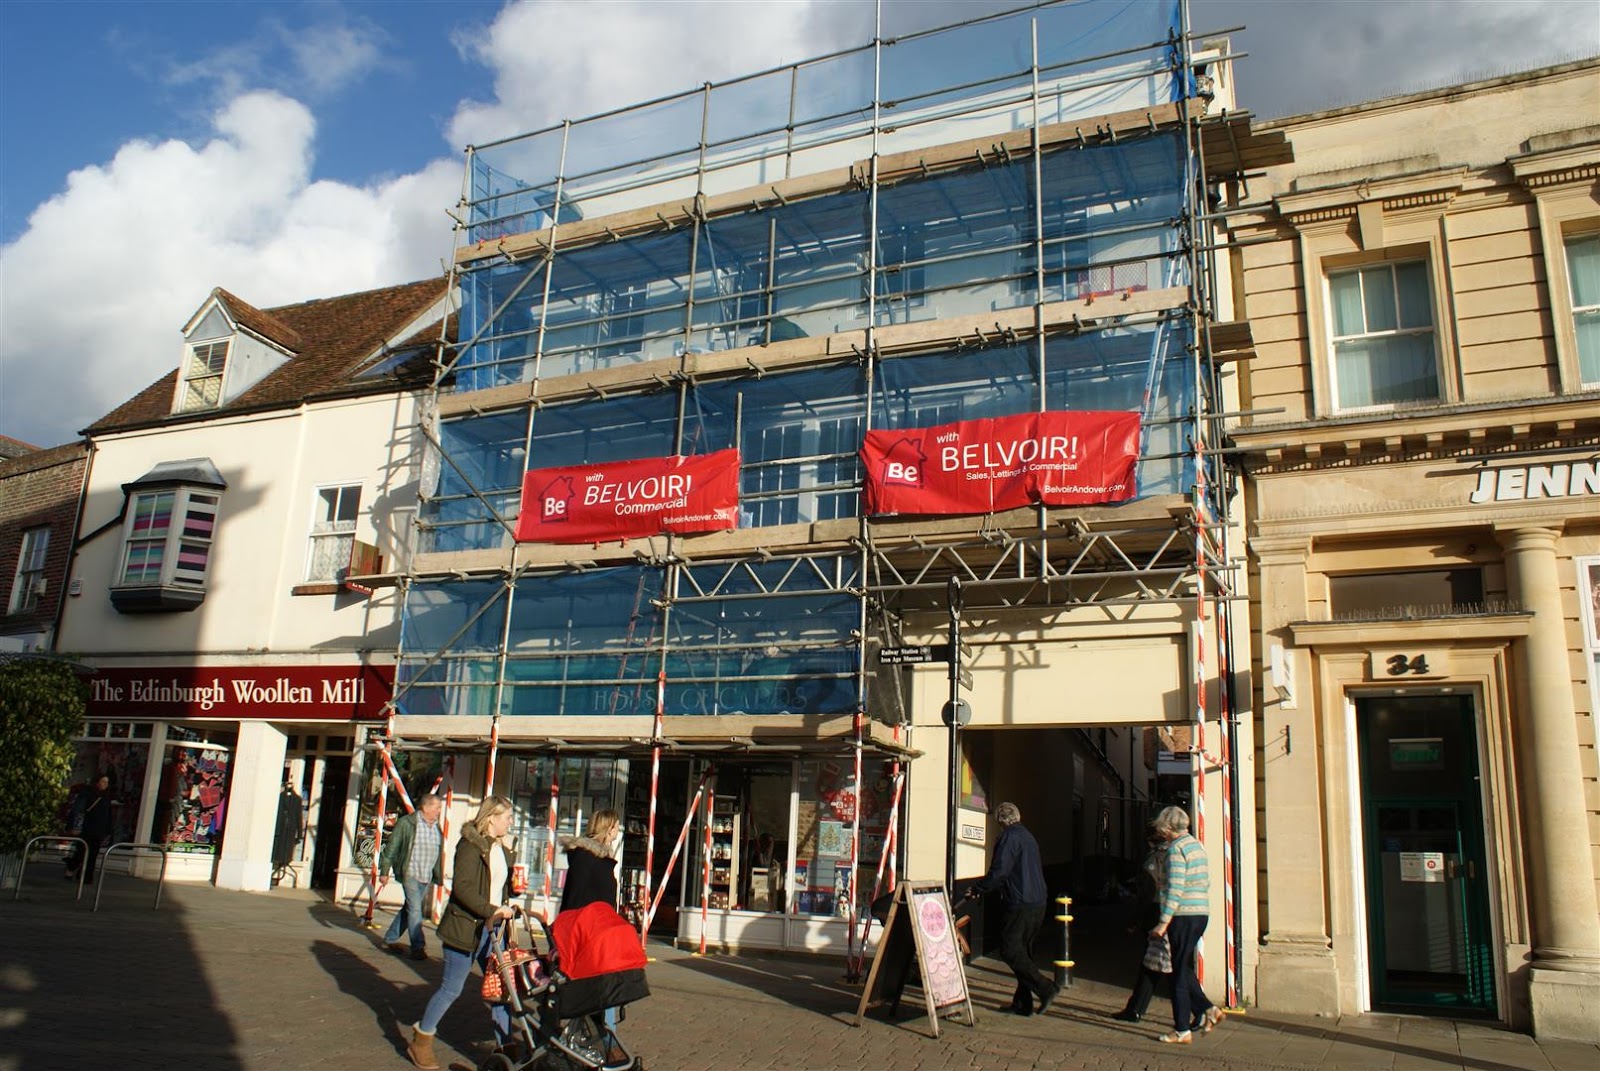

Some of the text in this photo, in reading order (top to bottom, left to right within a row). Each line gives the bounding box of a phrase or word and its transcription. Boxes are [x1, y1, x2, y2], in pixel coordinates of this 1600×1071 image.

[936, 432, 960, 444] with
[941, 436, 1078, 472] BELVOIR!
[585, 473, 604, 483] with
[887, 462, 918, 482] Be
[966, 471, 991, 481] Sales,
[992, 468, 1021, 479] Lettings
[1029, 462, 1078, 472] Commercial
[584, 475, 692, 506] BELVOIR!
[1044, 483, 1125, 495] BelvoirAndover.com
[545, 497, 566, 516] Be
[615, 494, 688, 516] Commercial
[663, 511, 730, 525] BelvoirAndover.com
[1386, 654, 1429, 676] 34
[91, 677, 366, 710] The Edinburgh Woollen Mill
